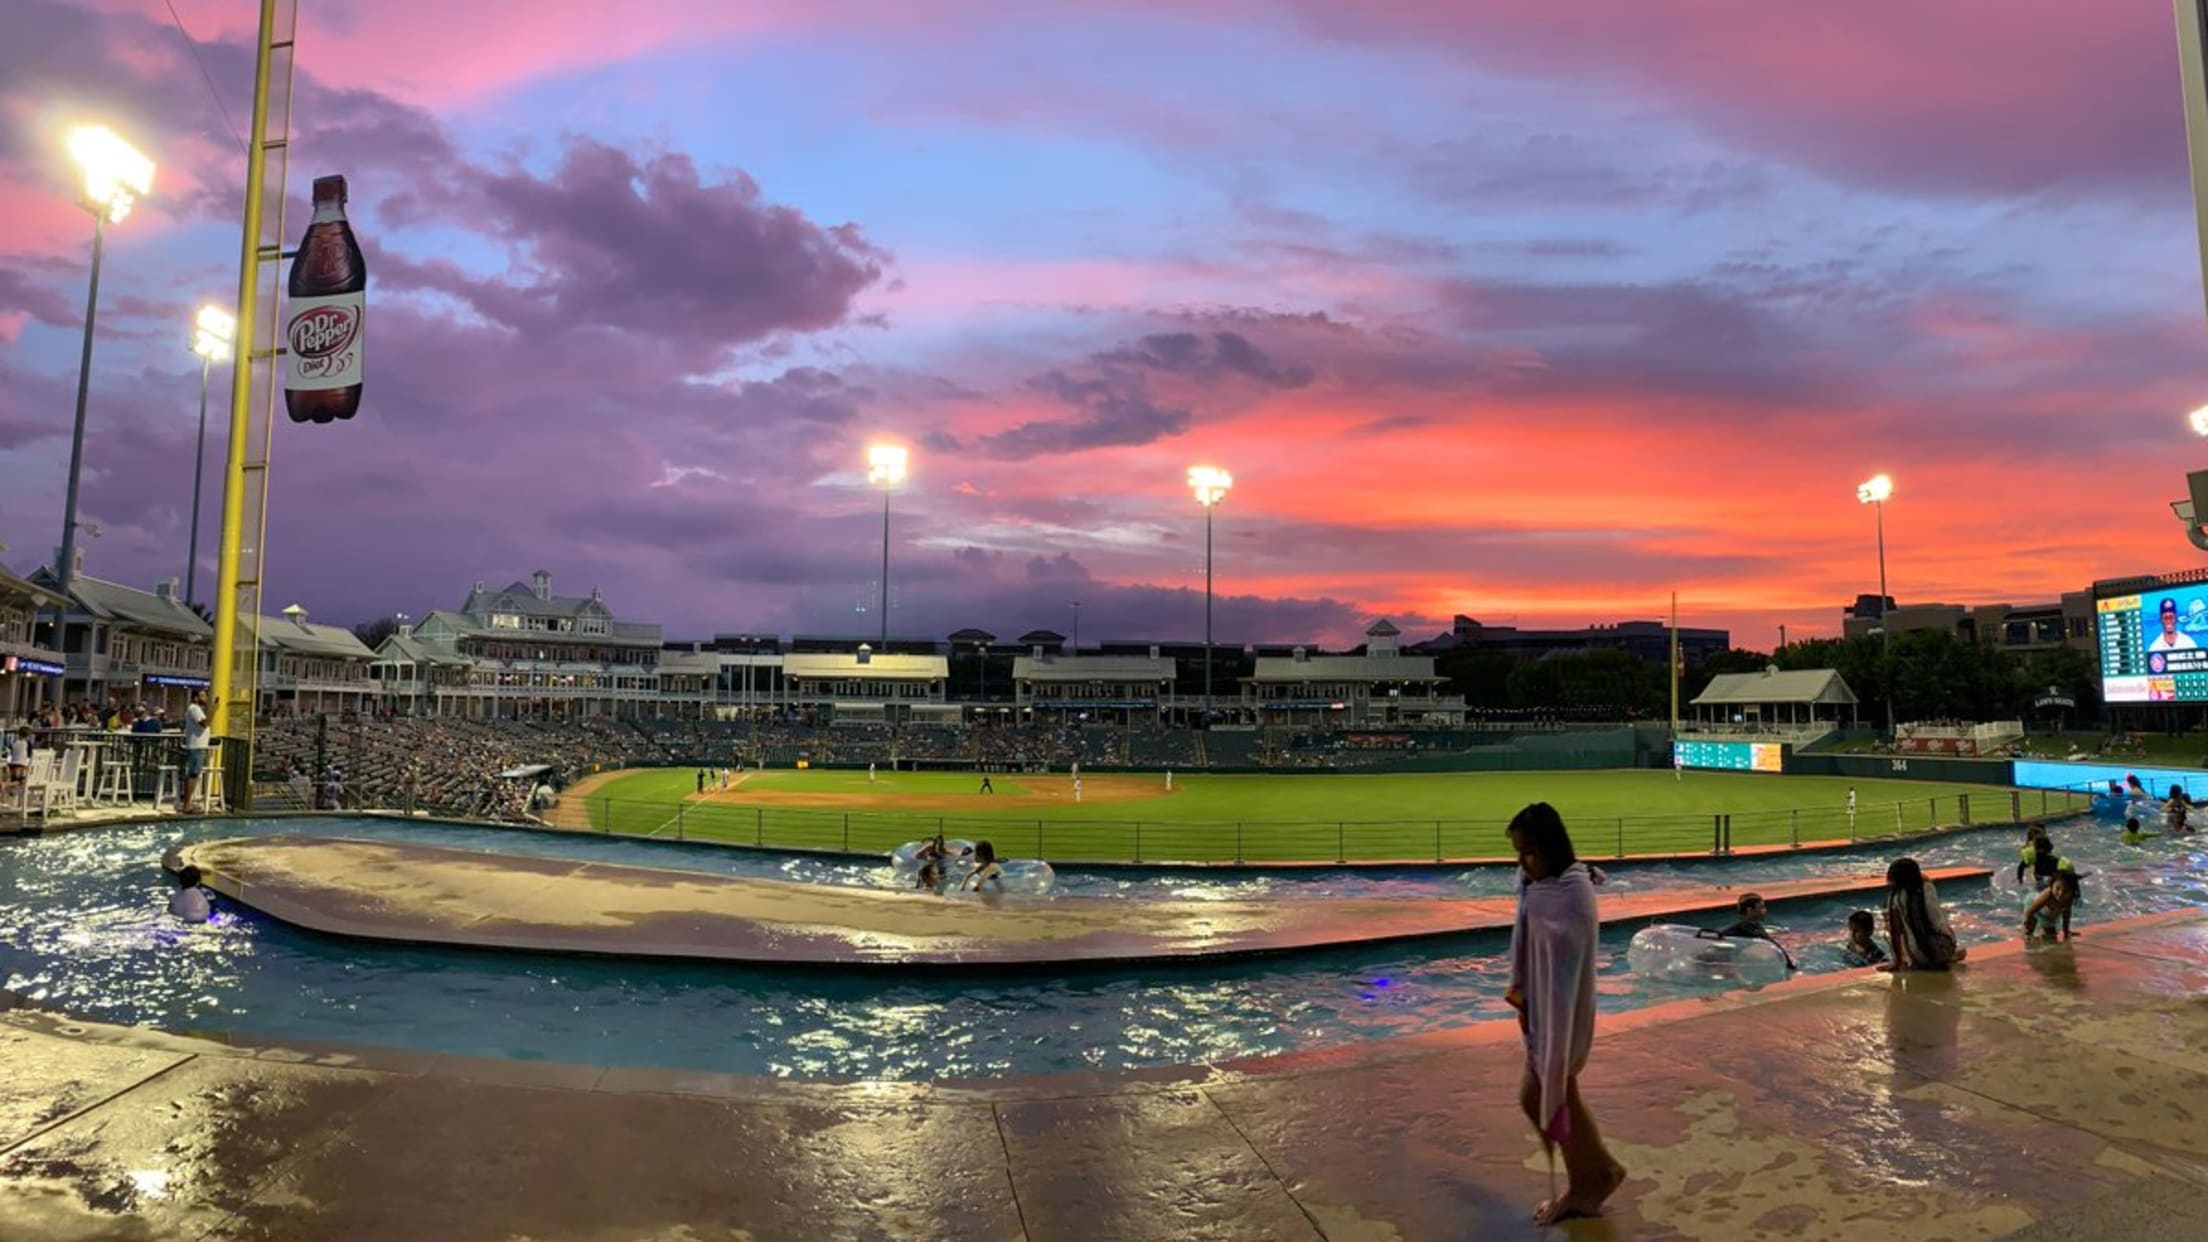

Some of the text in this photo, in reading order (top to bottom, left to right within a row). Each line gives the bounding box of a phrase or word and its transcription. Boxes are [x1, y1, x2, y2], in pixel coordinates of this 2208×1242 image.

[315, 314, 338, 332] Dr
[299, 319, 351, 352] Pepper
[303, 358, 325, 373] Diet
